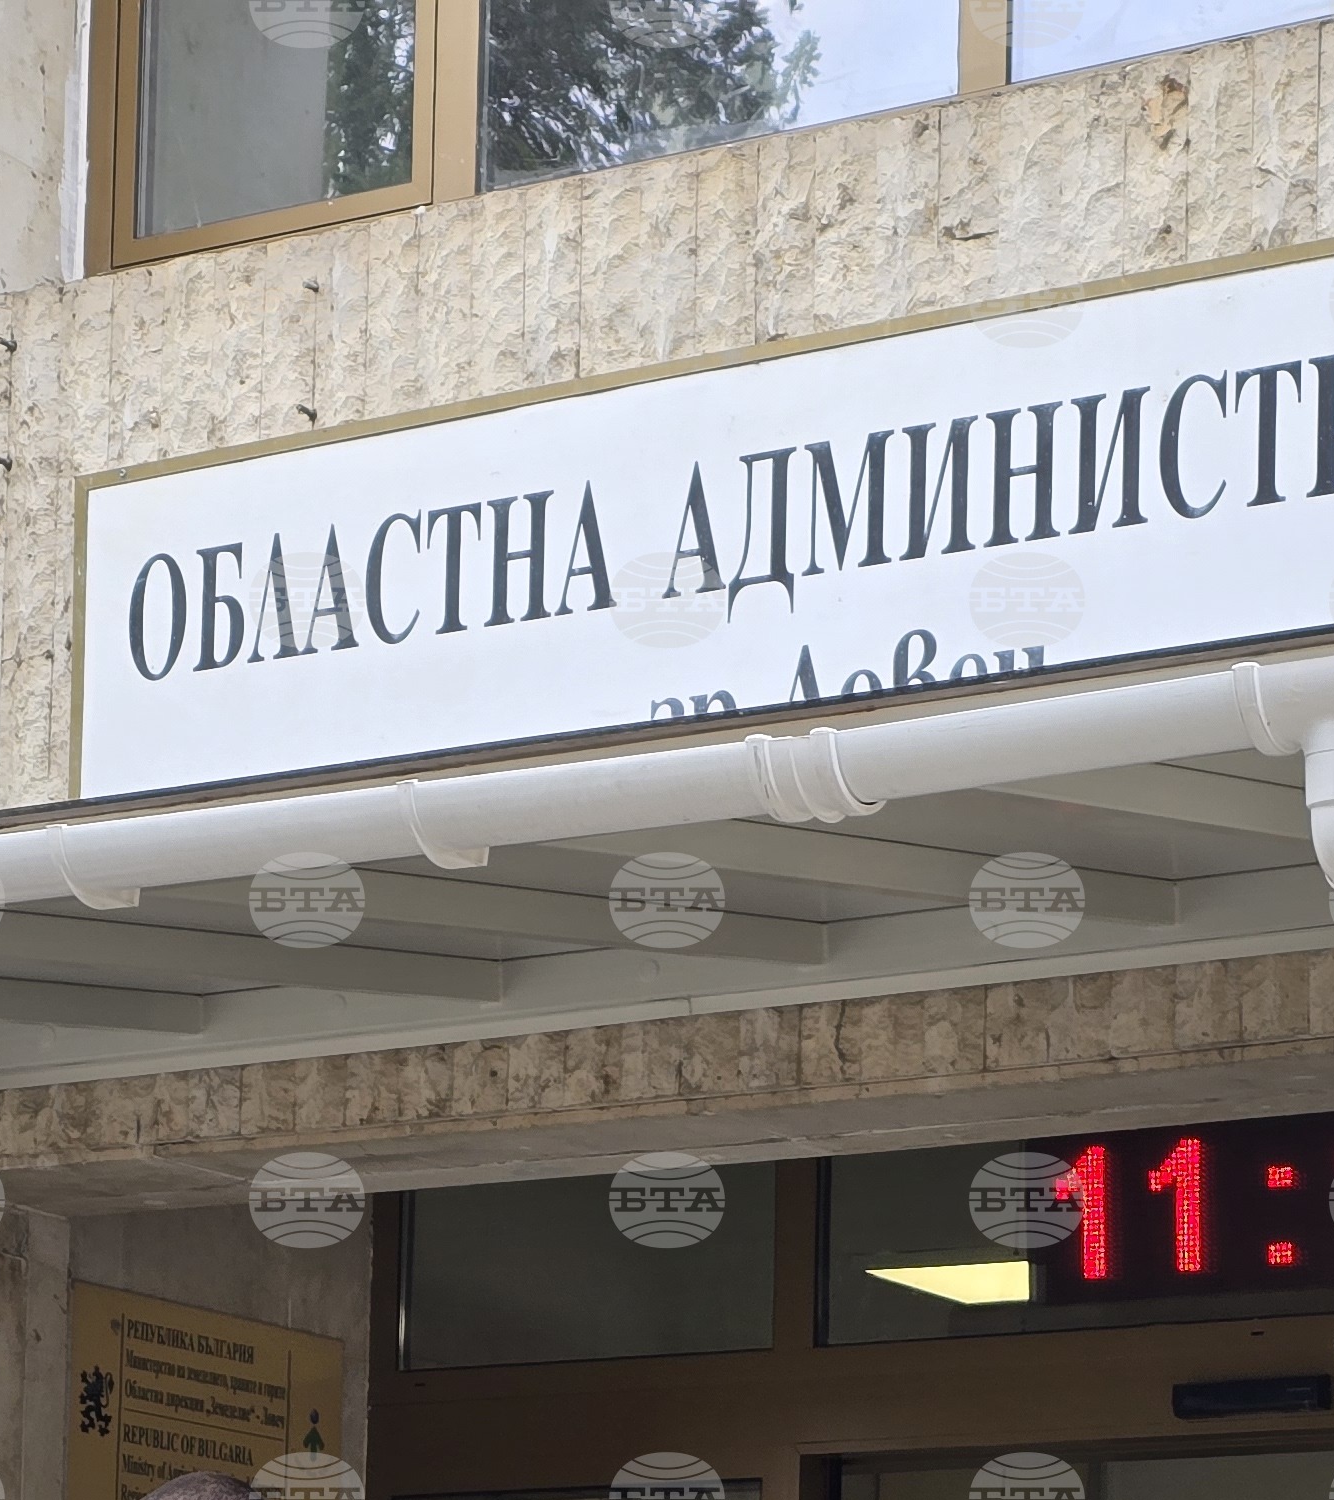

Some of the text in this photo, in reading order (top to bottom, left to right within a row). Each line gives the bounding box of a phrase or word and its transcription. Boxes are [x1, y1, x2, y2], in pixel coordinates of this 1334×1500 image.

[128, 484, 615, 683] ОБЛАСТНА
[126, 1319, 254, 1364] РЕПУБЛИКА БЪЛГАРИЯ
[122, 1423, 254, 1467] REPUBLIC OF BULGARIA
